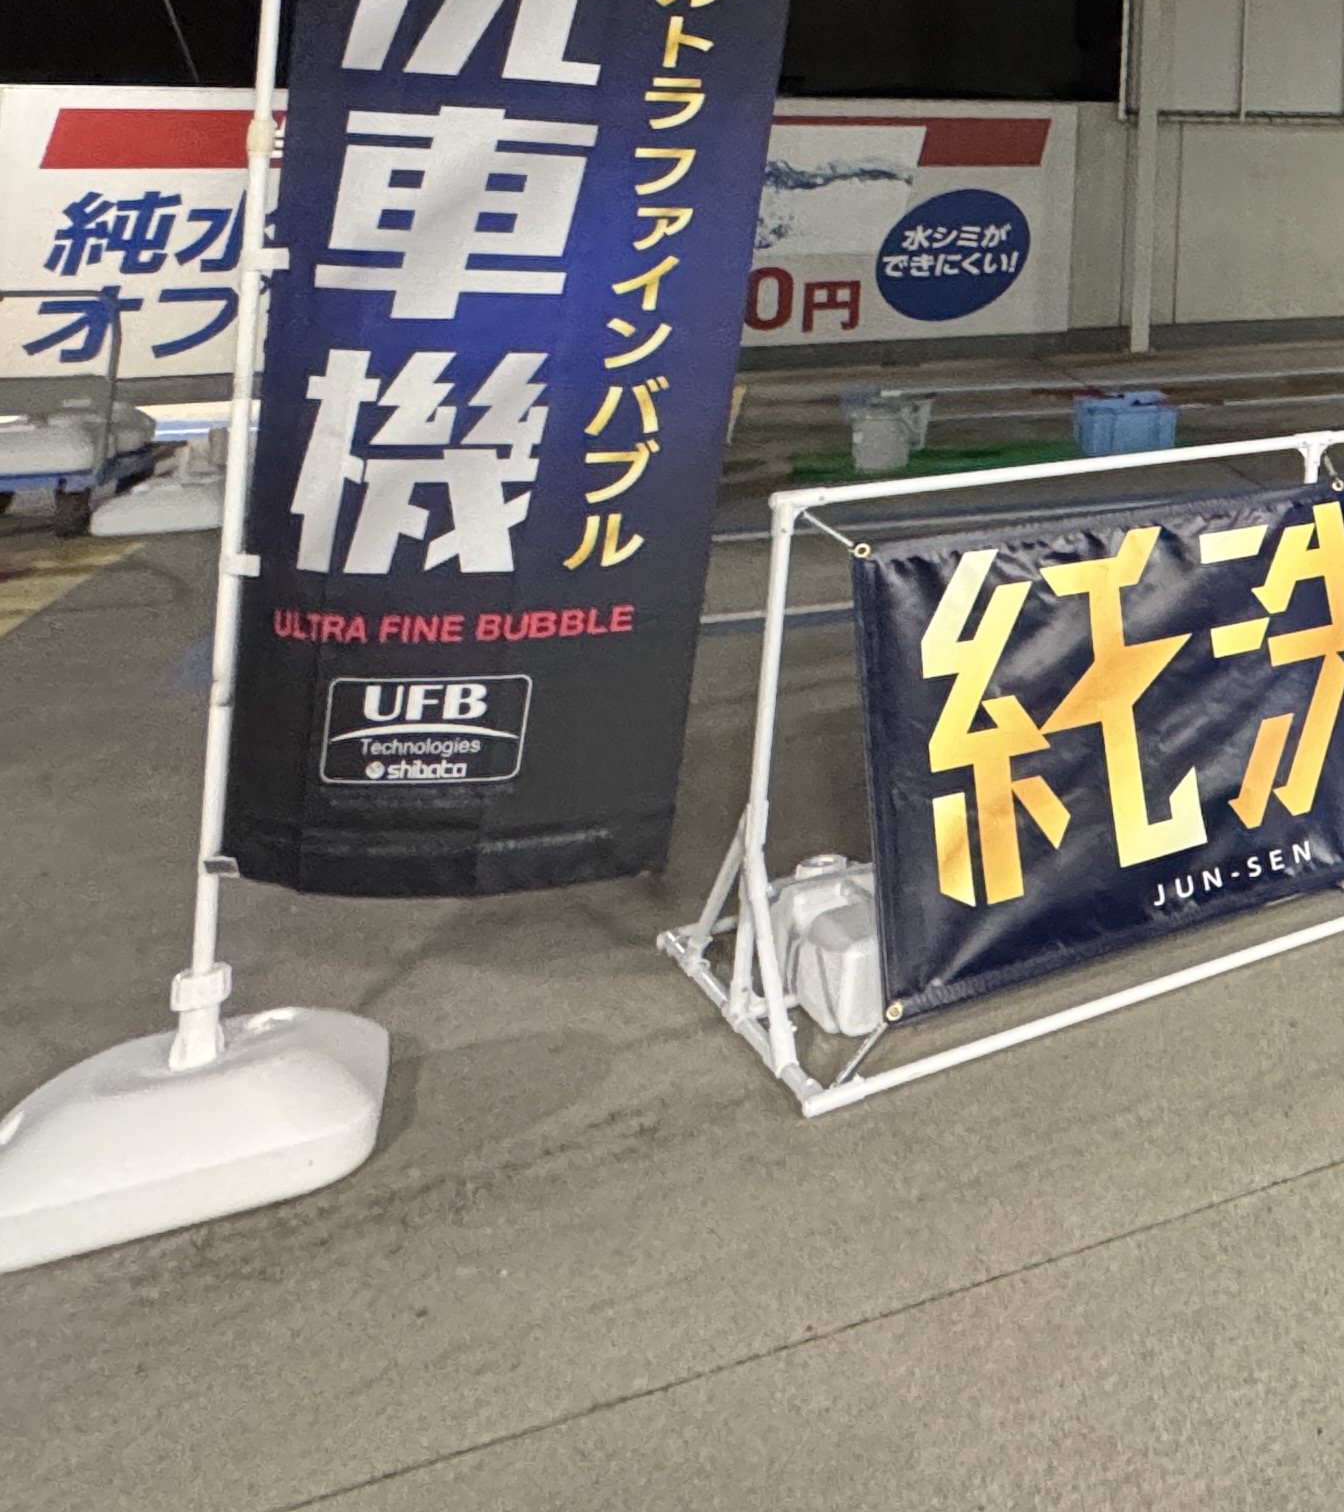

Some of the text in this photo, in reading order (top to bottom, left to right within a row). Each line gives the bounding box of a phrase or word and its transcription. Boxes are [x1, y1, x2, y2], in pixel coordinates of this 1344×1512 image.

[902, 223, 1013, 252] 水シミが
[273, 603, 635, 644] ULTRA FINE BUBBLE
[363, 683, 488, 722] UFB
[360, 737, 482, 758] Technologies
[387, 760, 468, 780] shibata
[1153, 840, 1313, 908] JUN-SEN
